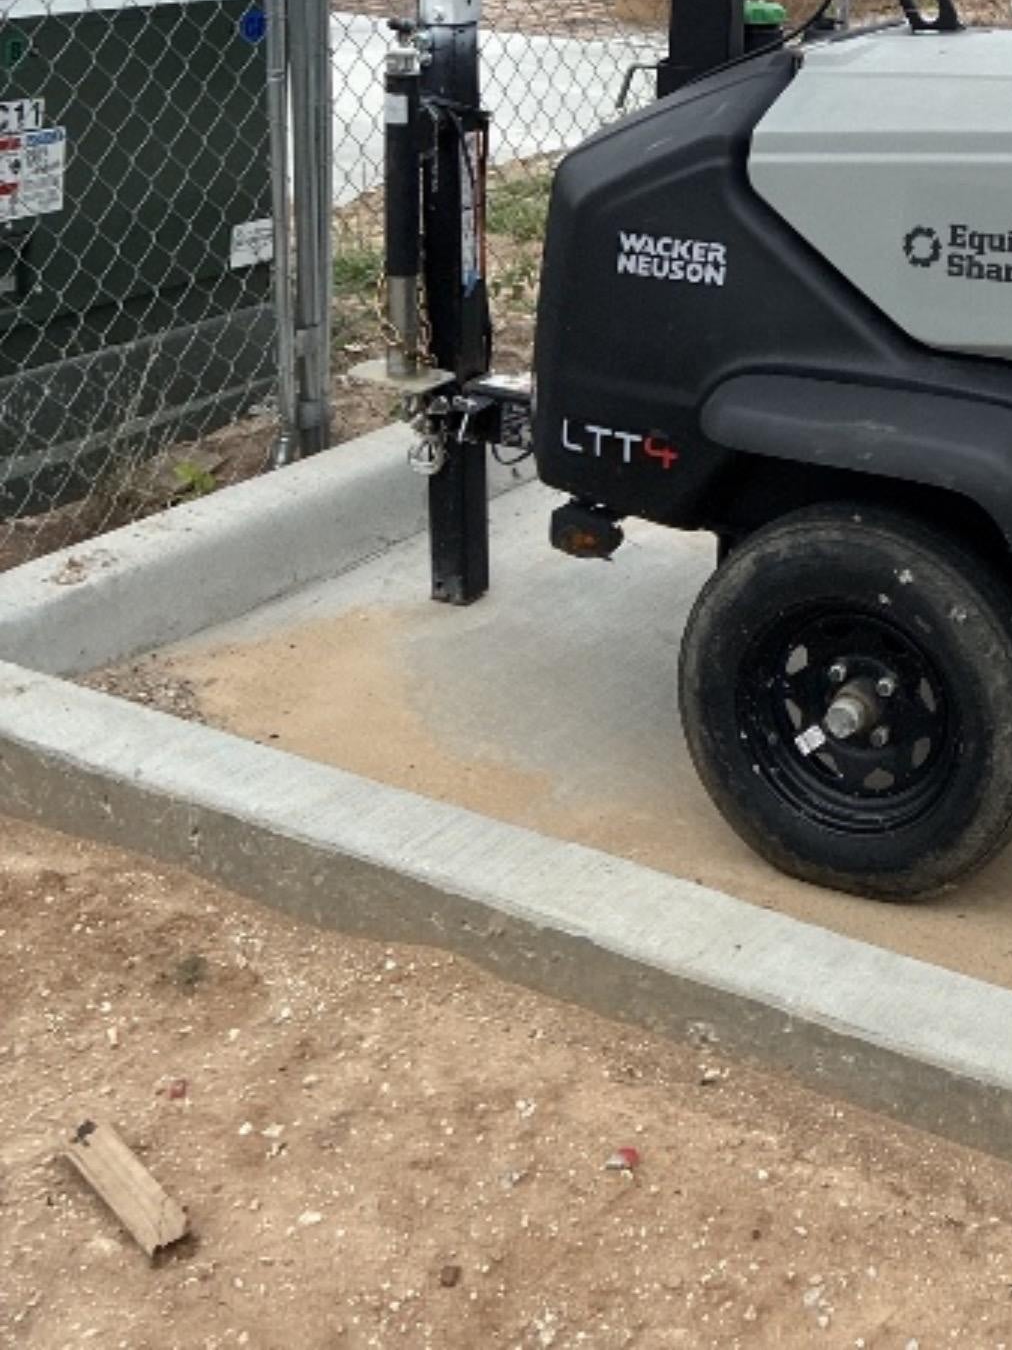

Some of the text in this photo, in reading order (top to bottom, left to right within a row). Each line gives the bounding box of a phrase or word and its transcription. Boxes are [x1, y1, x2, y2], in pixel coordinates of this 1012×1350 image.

[619, 230, 727, 265] WACKER
[617, 252, 727, 286] NEUSON
[562, 416, 679, 469] LTT4
